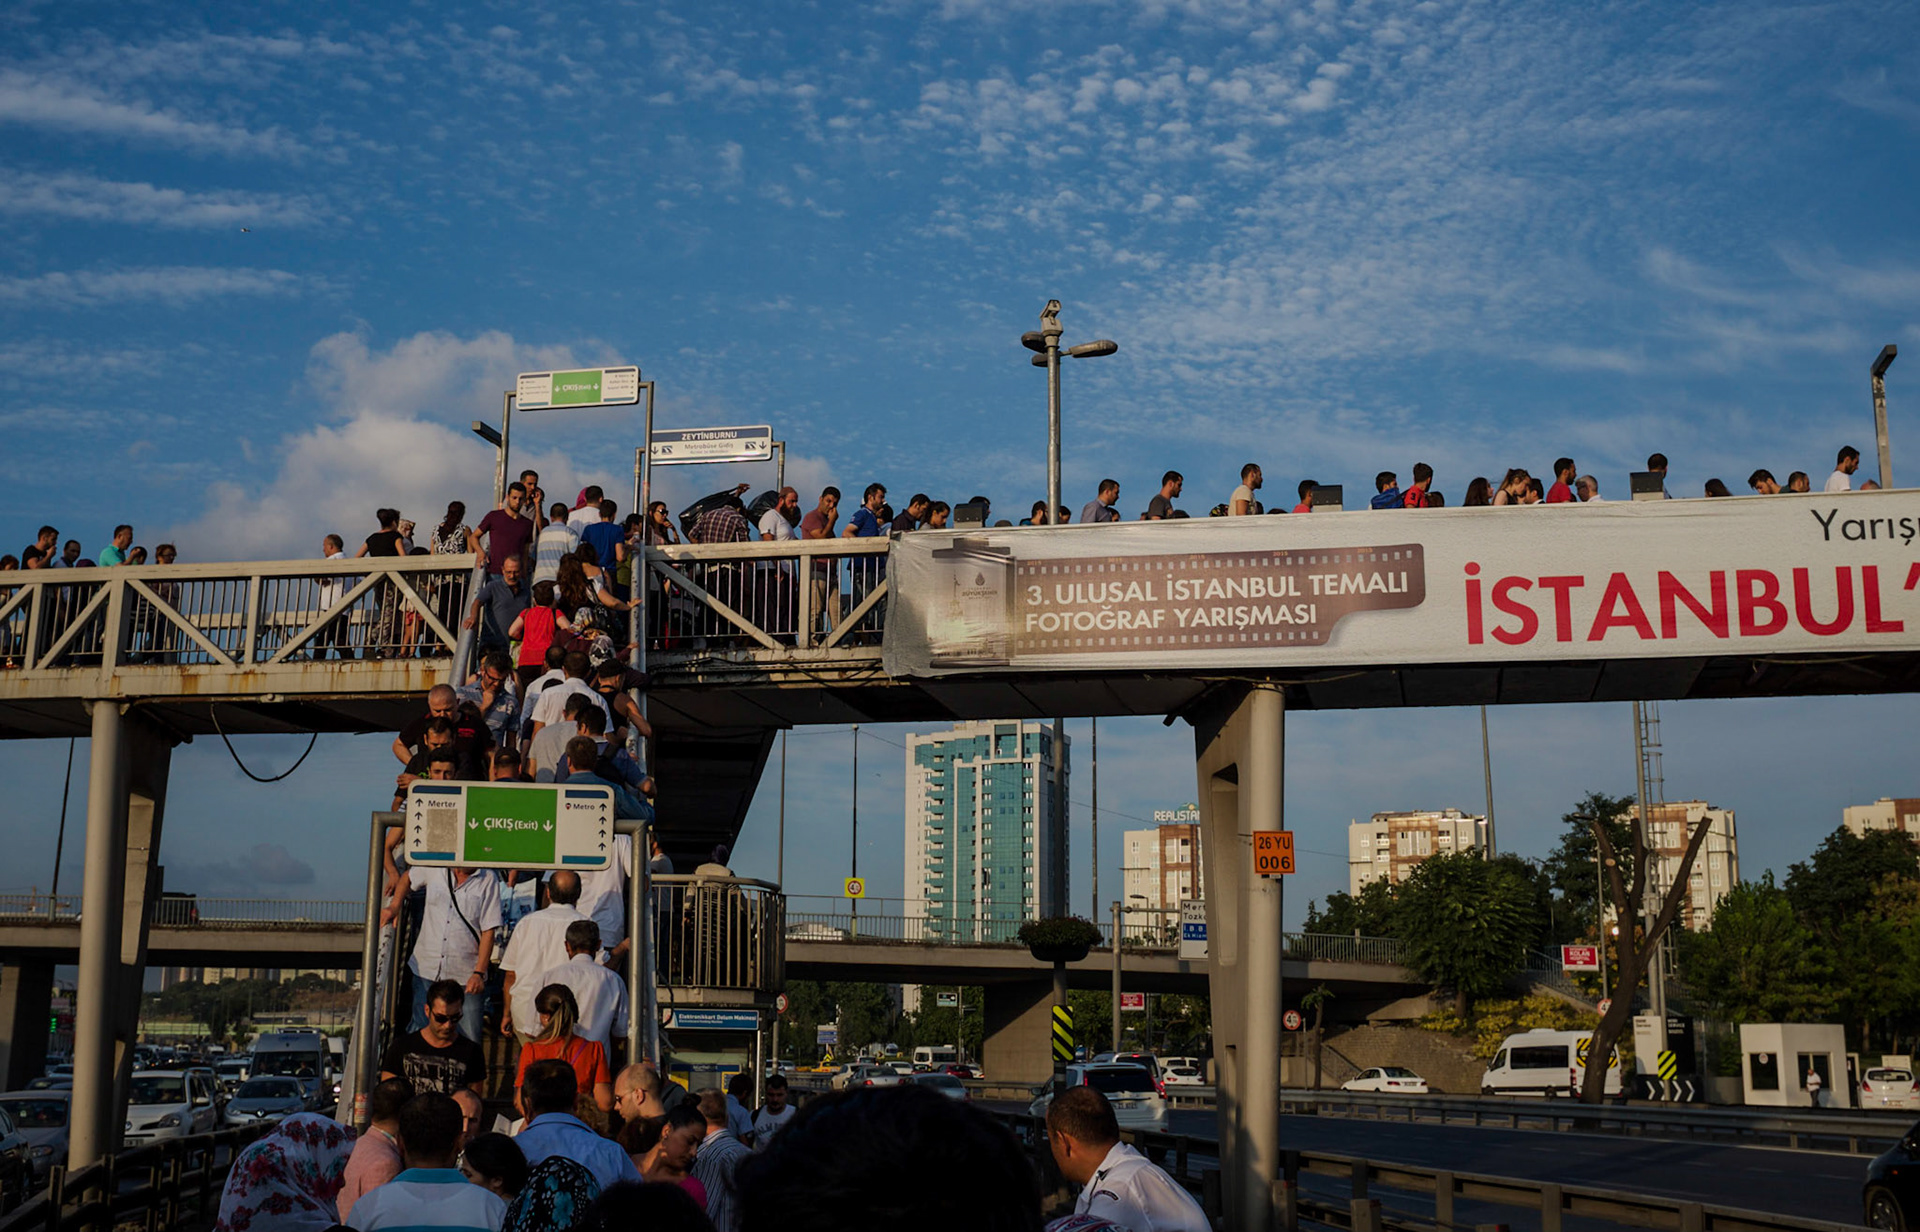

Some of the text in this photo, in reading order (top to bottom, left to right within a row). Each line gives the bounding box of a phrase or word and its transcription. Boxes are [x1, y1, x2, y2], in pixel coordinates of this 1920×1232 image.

[681, 430, 738, 441] ZEYTİNBURNU
[1026, 571, 1408, 606] 3. ULUSAL İSTANBUL TEMALI
[1026, 604, 1316, 632] FOTOĞRAF YARIŞMASI
[428, 800, 456, 808] Merter
[1258, 836, 1290, 849] 26 YU
[1259, 856, 1291, 870] 006
